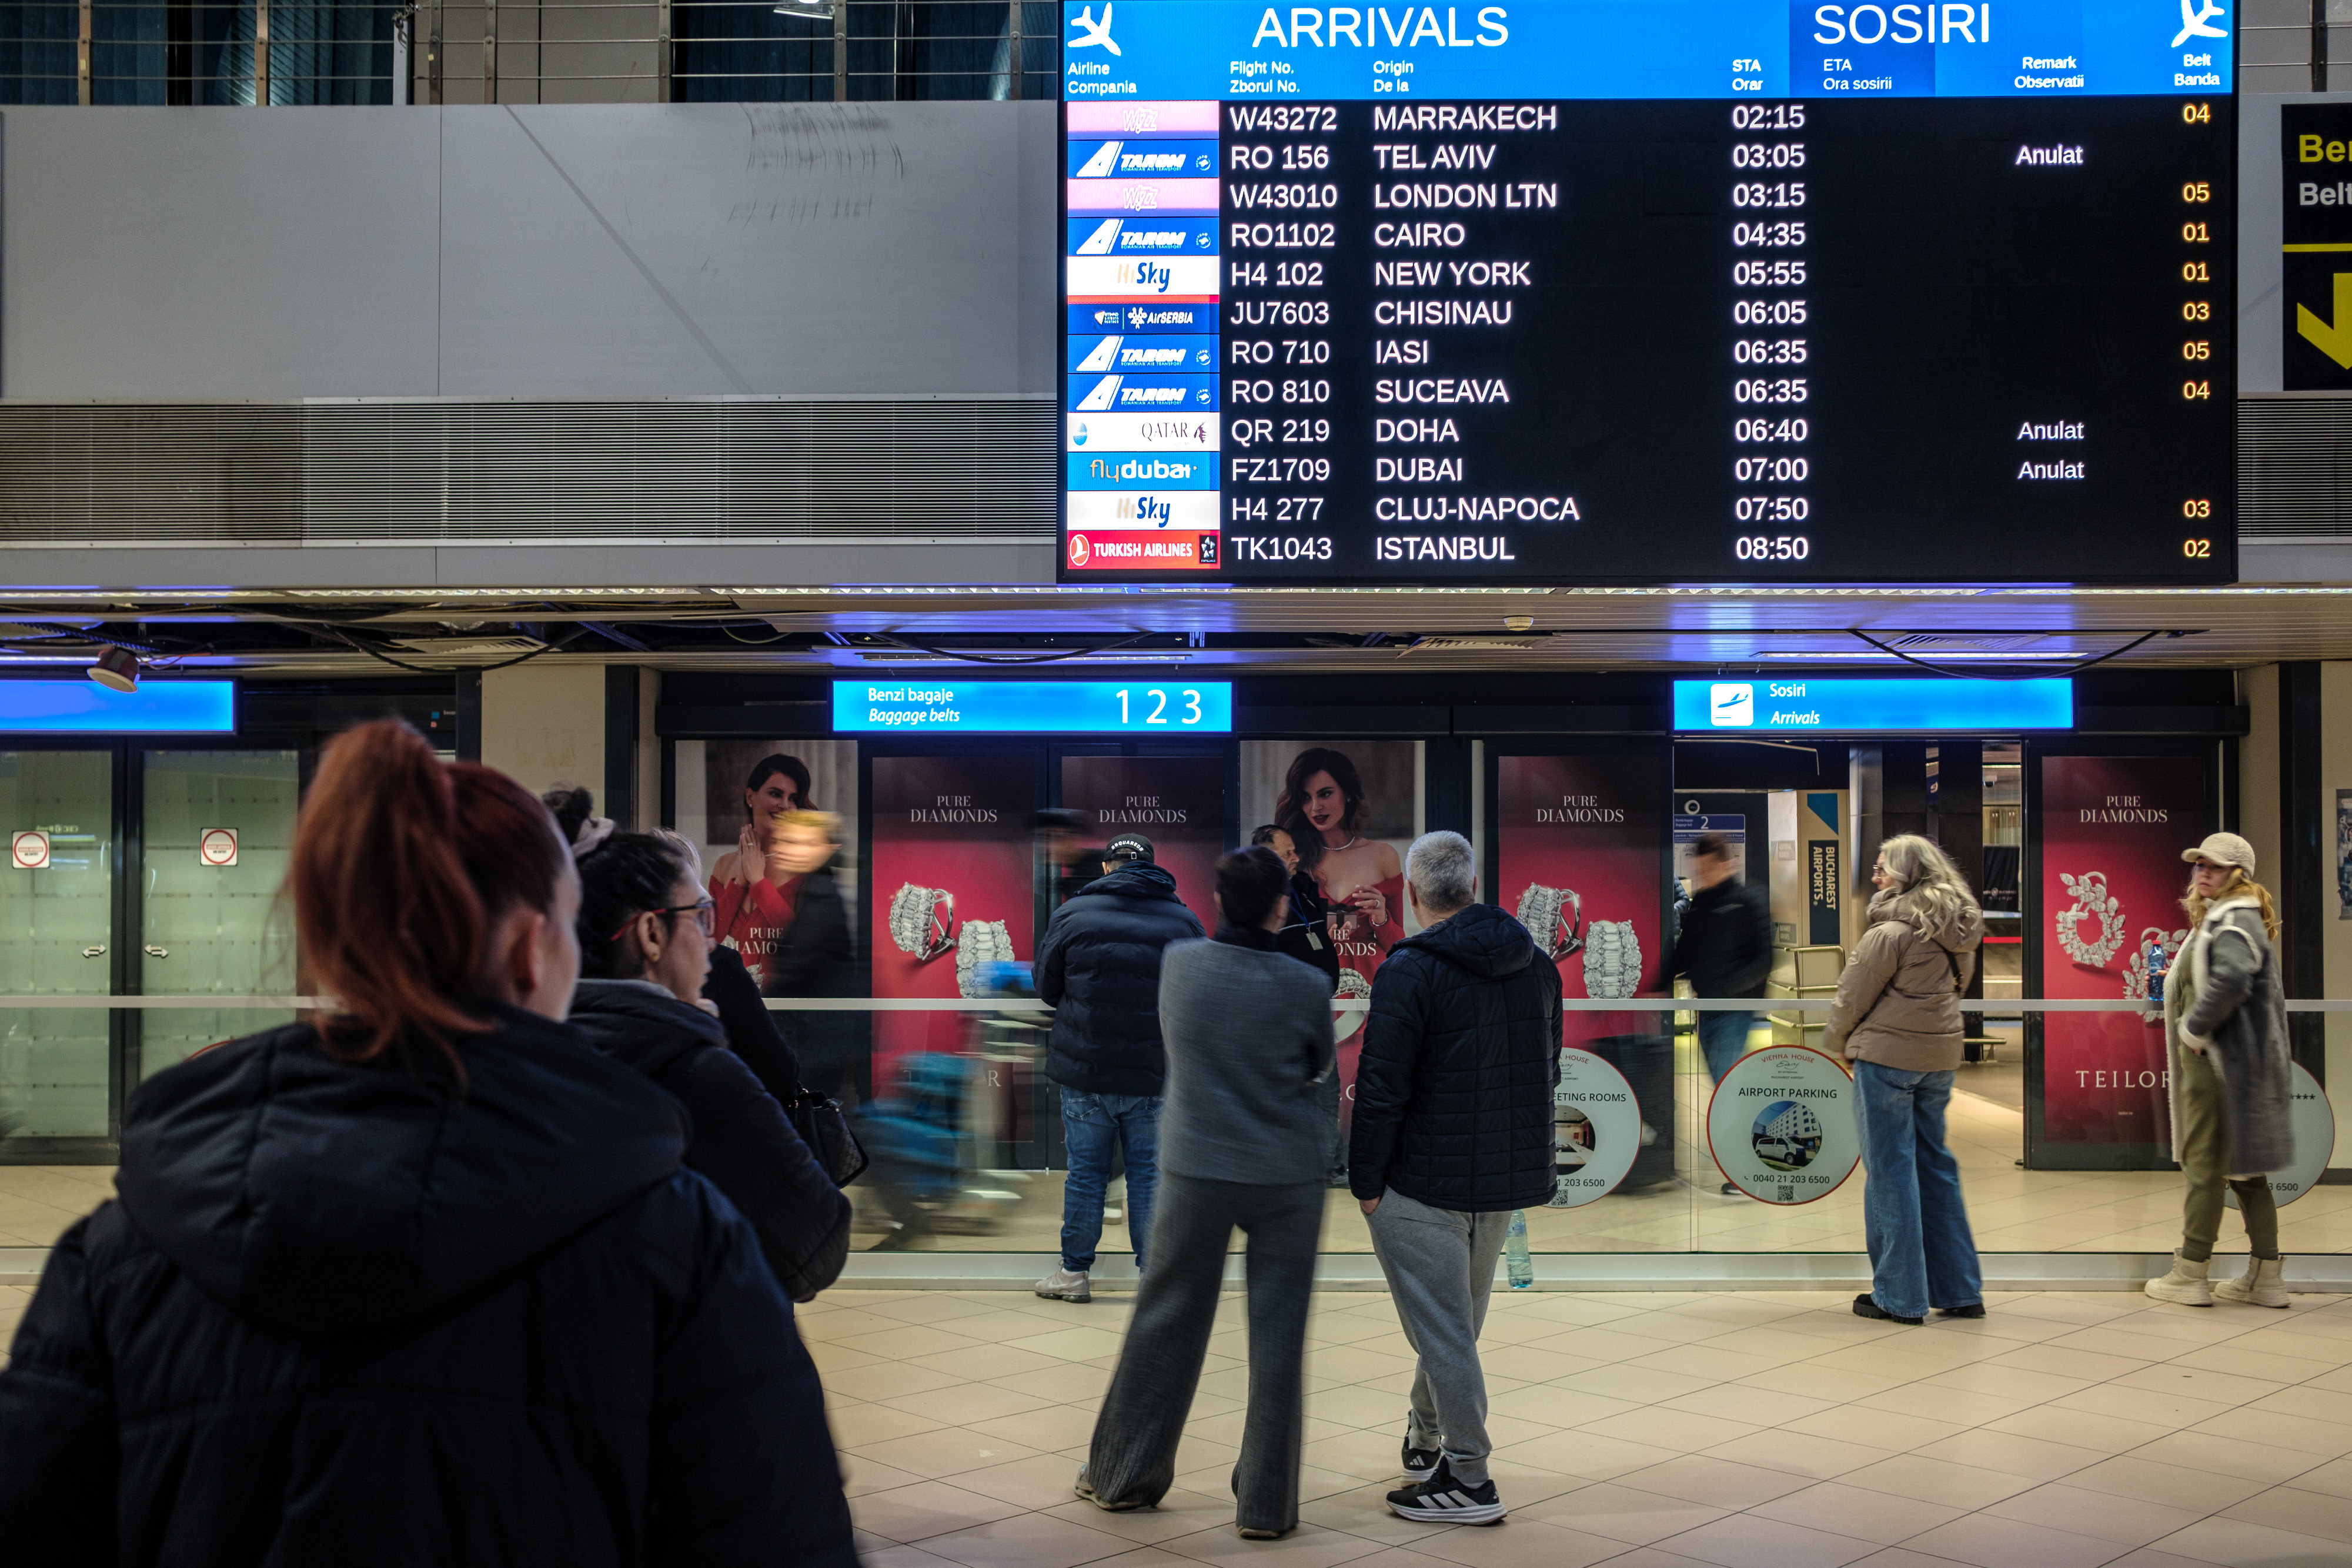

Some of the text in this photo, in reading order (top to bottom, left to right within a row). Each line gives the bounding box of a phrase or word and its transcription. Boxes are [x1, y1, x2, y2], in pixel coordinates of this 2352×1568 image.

[1252, 7, 1509, 48] ARRIVALS
[1813, 4, 1989, 44] SOSIRI
[1732, 59, 1762, 72] STA
[1823, 59, 1852, 71] ETA
[2022, 56, 2077, 69] Remark
[2183, 53, 2212, 67] Belt
[1067, 62, 1110, 75] Airline
[1230, 61, 1294, 77] Flight No.
[1373, 61, 1414, 76] Origin
[1230, 79, 1300, 93] Zborul No.
[1374, 78, 1409, 92] De la
[1732, 78, 1763, 91] Orar
[1823, 76, 1892, 90] Ora sosirii
[2014, 74, 2084, 88] Observatii
[2174, 72, 2220, 86] Banda
[1068, 80, 1137, 96] Compania
[1230, 104, 2210, 131] W43272 MARRAKECH 02:15 04
[1231, 146, 1273, 170] RO
[1282, 145, 1329, 169] 156
[1373, 145, 1428, 169] TEL
[1431, 145, 1496, 169] AVIV
[1733, 144, 1805, 168] 03:05
[2016, 145, 2083, 165] Anulat
[1230, 183, 2210, 209] W43010 LONDON LTN 03:15 05
[1231, 223, 1335, 247] RO1102
[1375, 223, 1465, 246] CAIRO
[1733, 222, 1805, 246] 04:35
[2183, 223, 2209, 242] 01
[1232, 262, 2210, 286] H4 102 NEW YORK 05:55 01
[1230, 300, 2210, 325] JU7603 CHISINAU 06:05 03
[1232, 341, 1273, 364] RO
[1282, 341, 1329, 363] 710
[1376, 340, 1428, 364] IASI
[1735, 340, 1807, 363] 06:35
[2183, 341, 2210, 360] 05
[1232, 380, 1274, 403] RO
[1282, 380, 1329, 403] 810
[1375, 379, 1509, 403] SUCEAVA
[1735, 379, 1807, 403] 06:35
[2183, 380, 2210, 399] 04
[1142, 422, 1188, 441] QATAR
[1231, 419, 2084, 443] QR 219 DOHA 06:40 Anulat
[1232, 458, 2084, 482] FZ1709 DUBAI 07:00 Anulat
[1232, 497, 2210, 521] H4 277 CLUJ-NAPOCA 07:50 03
[1094, 543, 1193, 557] TURKISH AIRLINES
[1231, 537, 2210, 560] TK1043 ISTANBUL 08:50 02
[1769, 683, 1806, 697] Sosiri
[868, 687, 1201, 724] Benzi bagaje 1 2 3
[868, 708, 960, 726] Baggage belts
[1770, 710, 1820, 724] Arrivals
[937, 795, 971, 807] PURE
[1127, 795, 1160, 807] PURE
[1563, 795, 1597, 807] PURE
[2107, 795, 2140, 807] PURE
[911, 809, 997, 823] DIAMONDS
[1100, 809, 1187, 823] DIAMONDS
[1537, 809, 1624, 823] DIAMONDS
[1700, 816, 1709, 830] 2
[2080, 809, 2167, 823] DIAMONDS
[1826, 847, 1836, 910] BUCHAREST
[750, 927, 783, 938] PURE
[1334, 929, 1349, 940] RE
[725, 941, 777, 954] DIAMO
[1334, 942, 1377, 956] ONDS
[1565, 1055, 1589, 1064] HOUSE
[1761, 1054, 1815, 1064] VIENNA HOUSE
[1554, 1092, 1626, 1102] ETING ROOMS
[1738, 1088, 1838, 1099] AIRPORT PARKING
[1565, 1178, 1581, 1186] 203
[1753, 1174, 1775, 1182] 0040
[1790, 1175, 1806, 1183] 203
[1808, 1176, 1830, 1184] 6500
[2276, 1182, 2298, 1191] 6500
